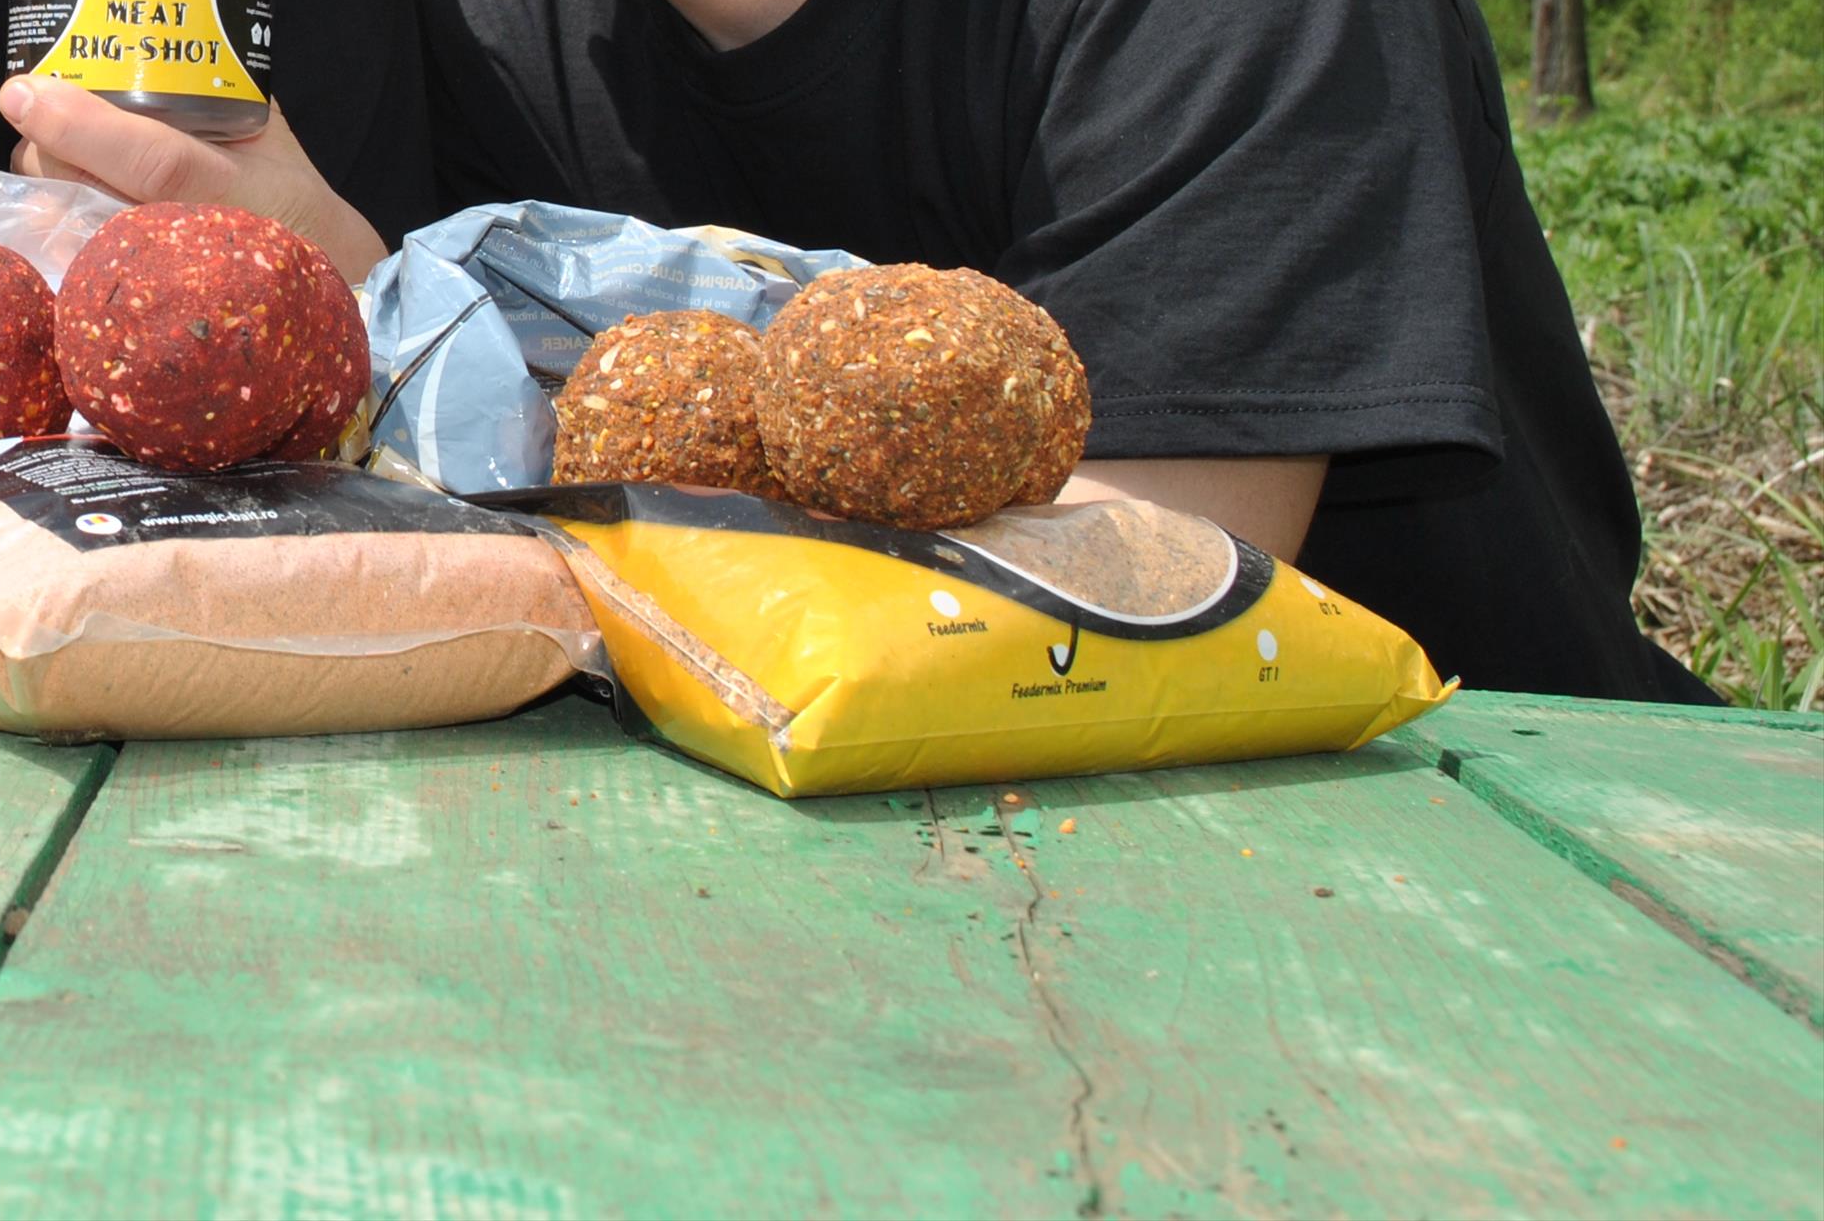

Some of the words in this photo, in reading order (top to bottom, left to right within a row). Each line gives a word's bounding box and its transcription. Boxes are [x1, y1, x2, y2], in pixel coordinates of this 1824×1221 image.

[106, 0, 189, 27] MEAT
[69, 34, 222, 65] RIG-SHOT
[140, 509, 279, 527] www.magic-bait.ro
[1331, 603, 1342, 615] 2
[927, 618, 988, 637] Feedermix
[1258, 666, 1273, 682] GT
[1011, 682, 1063, 699] Feedermix
[1065, 678, 1107, 695] Premium
